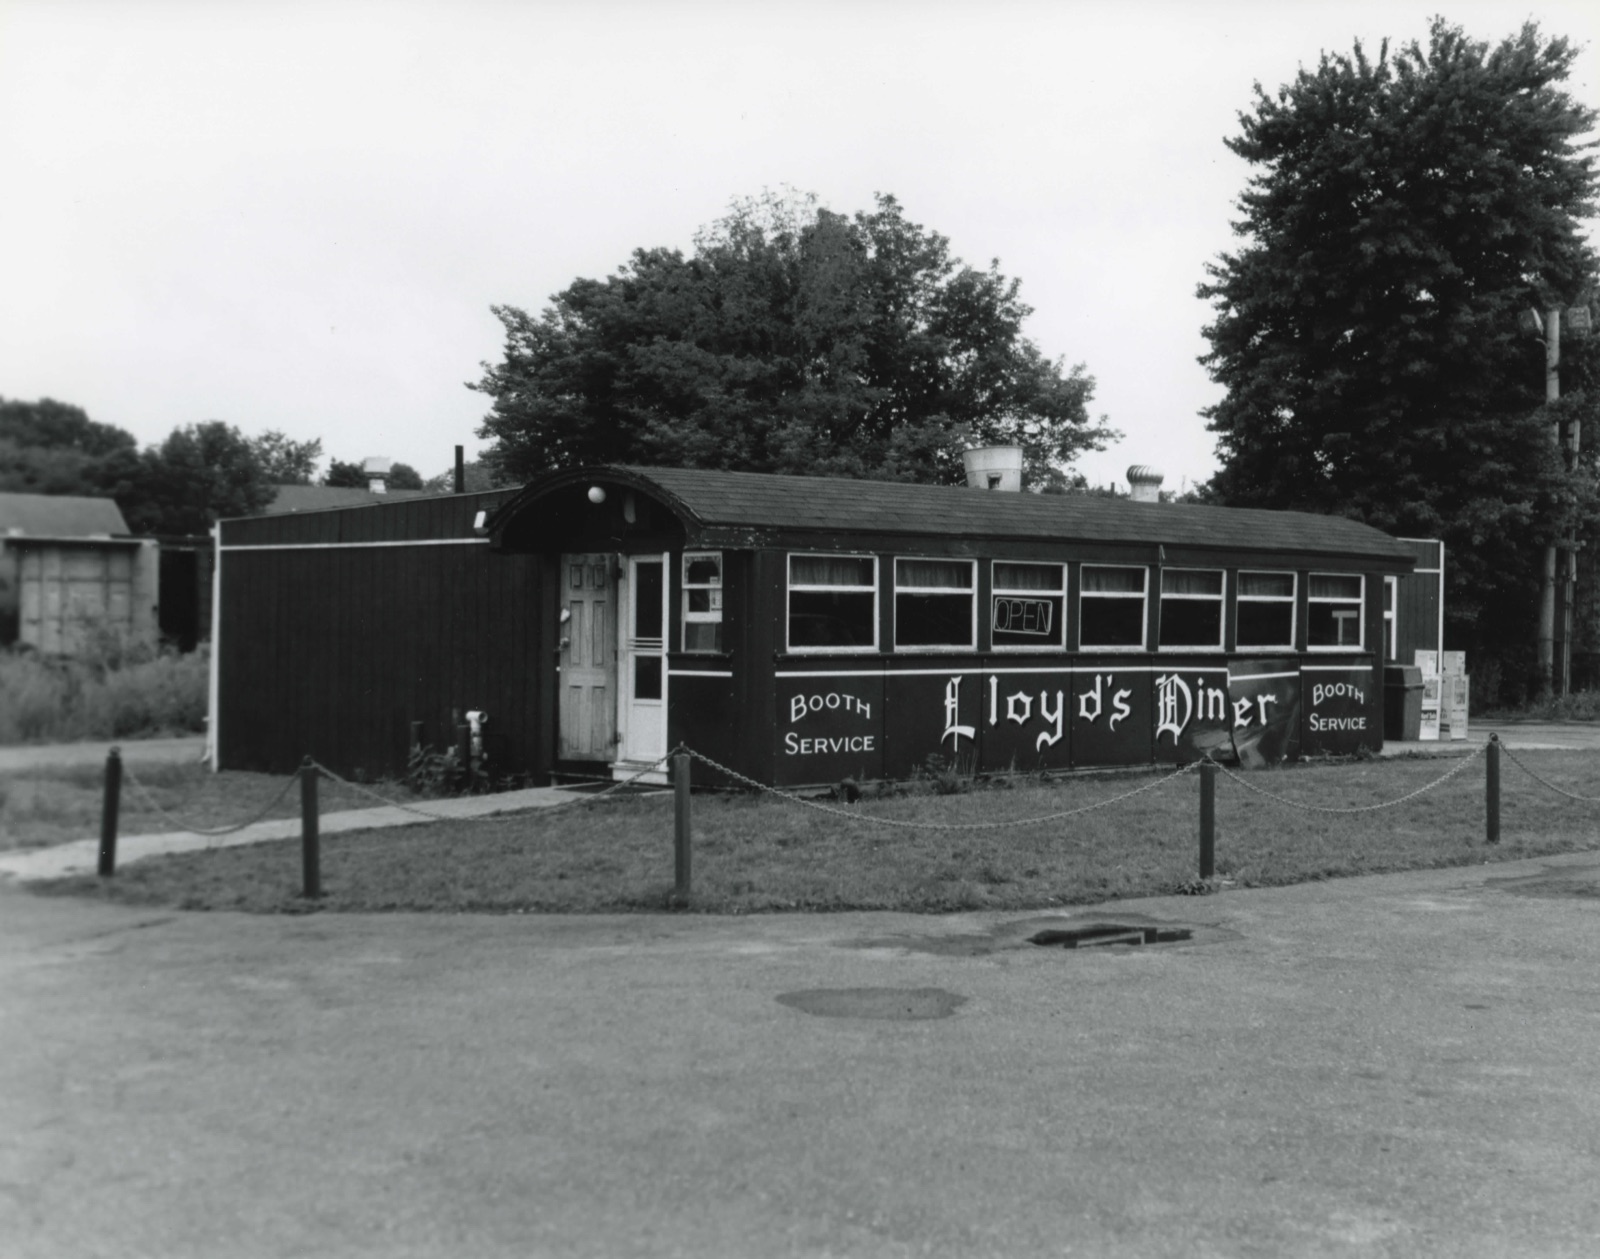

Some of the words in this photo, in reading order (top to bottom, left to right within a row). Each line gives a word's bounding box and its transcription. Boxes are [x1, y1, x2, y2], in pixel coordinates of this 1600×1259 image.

[996, 600, 1051, 633] OPEN
[790, 692, 871, 723] BOOTH
[1313, 682, 1364, 706] BOOTH
[941, 674, 1132, 753] Lloyd's
[1155, 673, 1278, 746] Diner
[1309, 713, 1367, 732] SERVICE
[785, 732, 875, 755] SERVICE
